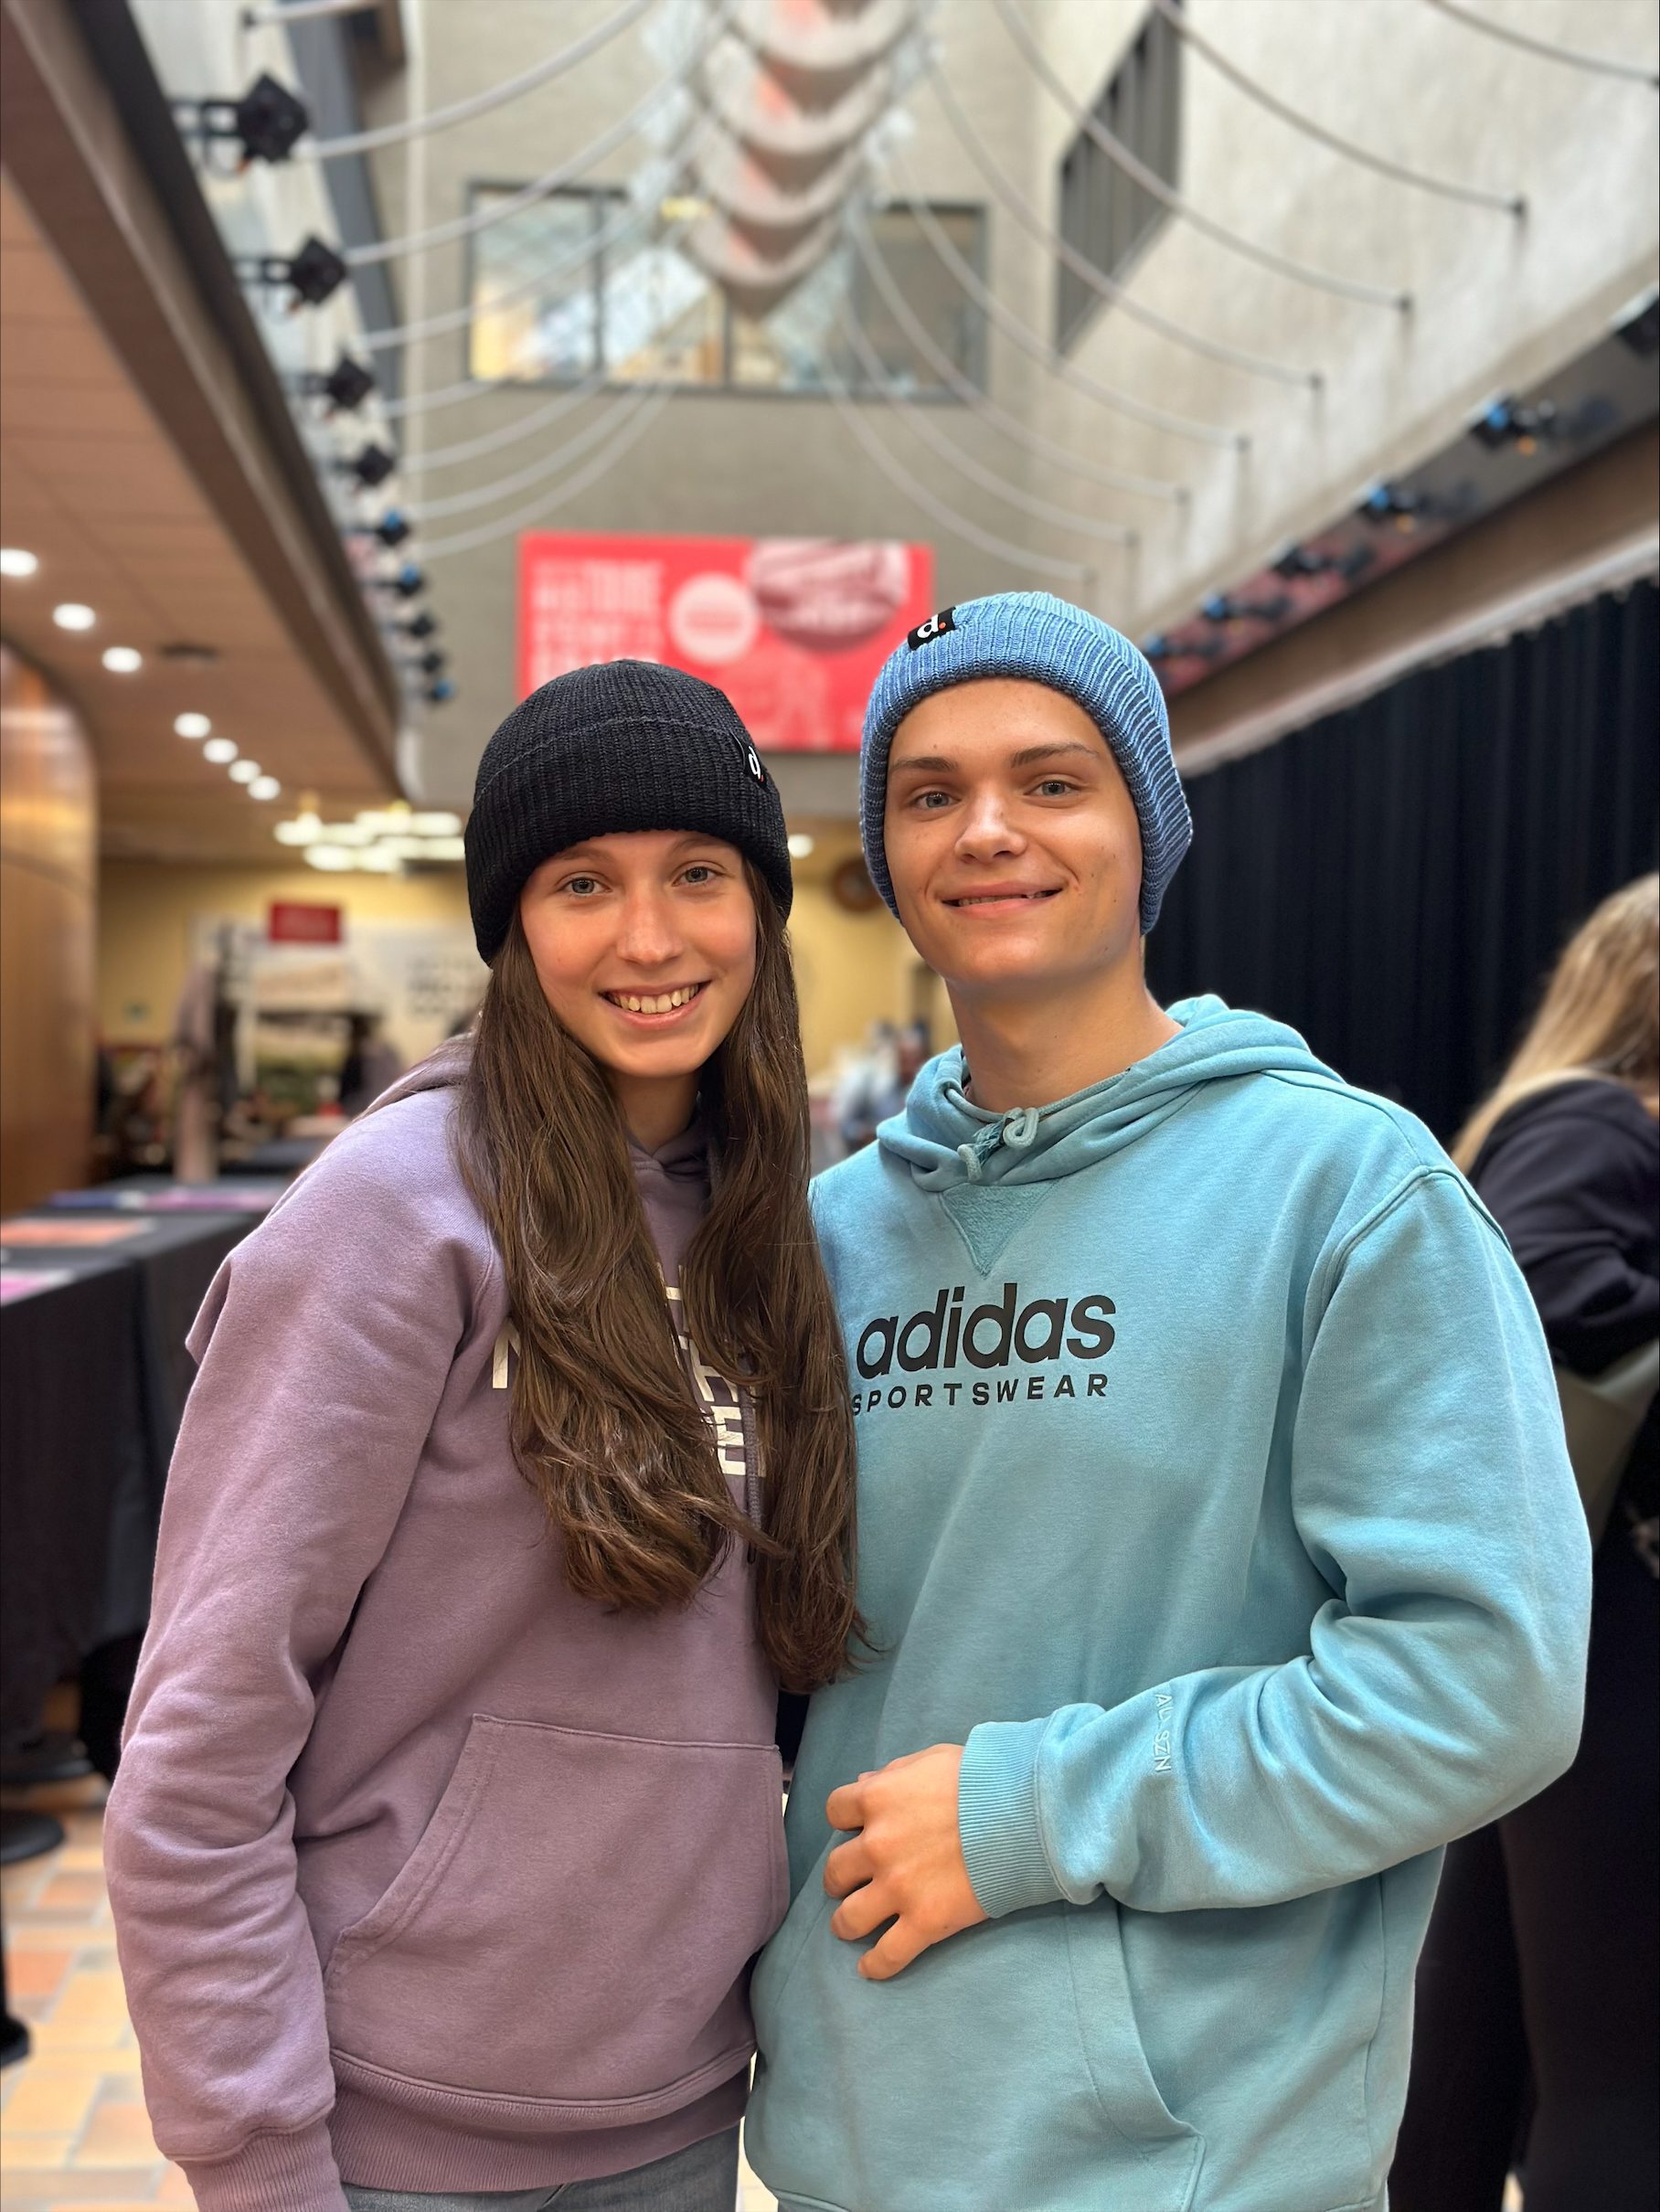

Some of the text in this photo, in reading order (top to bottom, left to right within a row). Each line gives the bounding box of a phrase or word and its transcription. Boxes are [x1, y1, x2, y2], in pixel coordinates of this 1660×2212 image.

[856, 1282, 1116, 1379] adidas
[851, 1373, 1109, 1416] SPORTSWEAR
[1154, 1729, 1172, 1773] SZN
